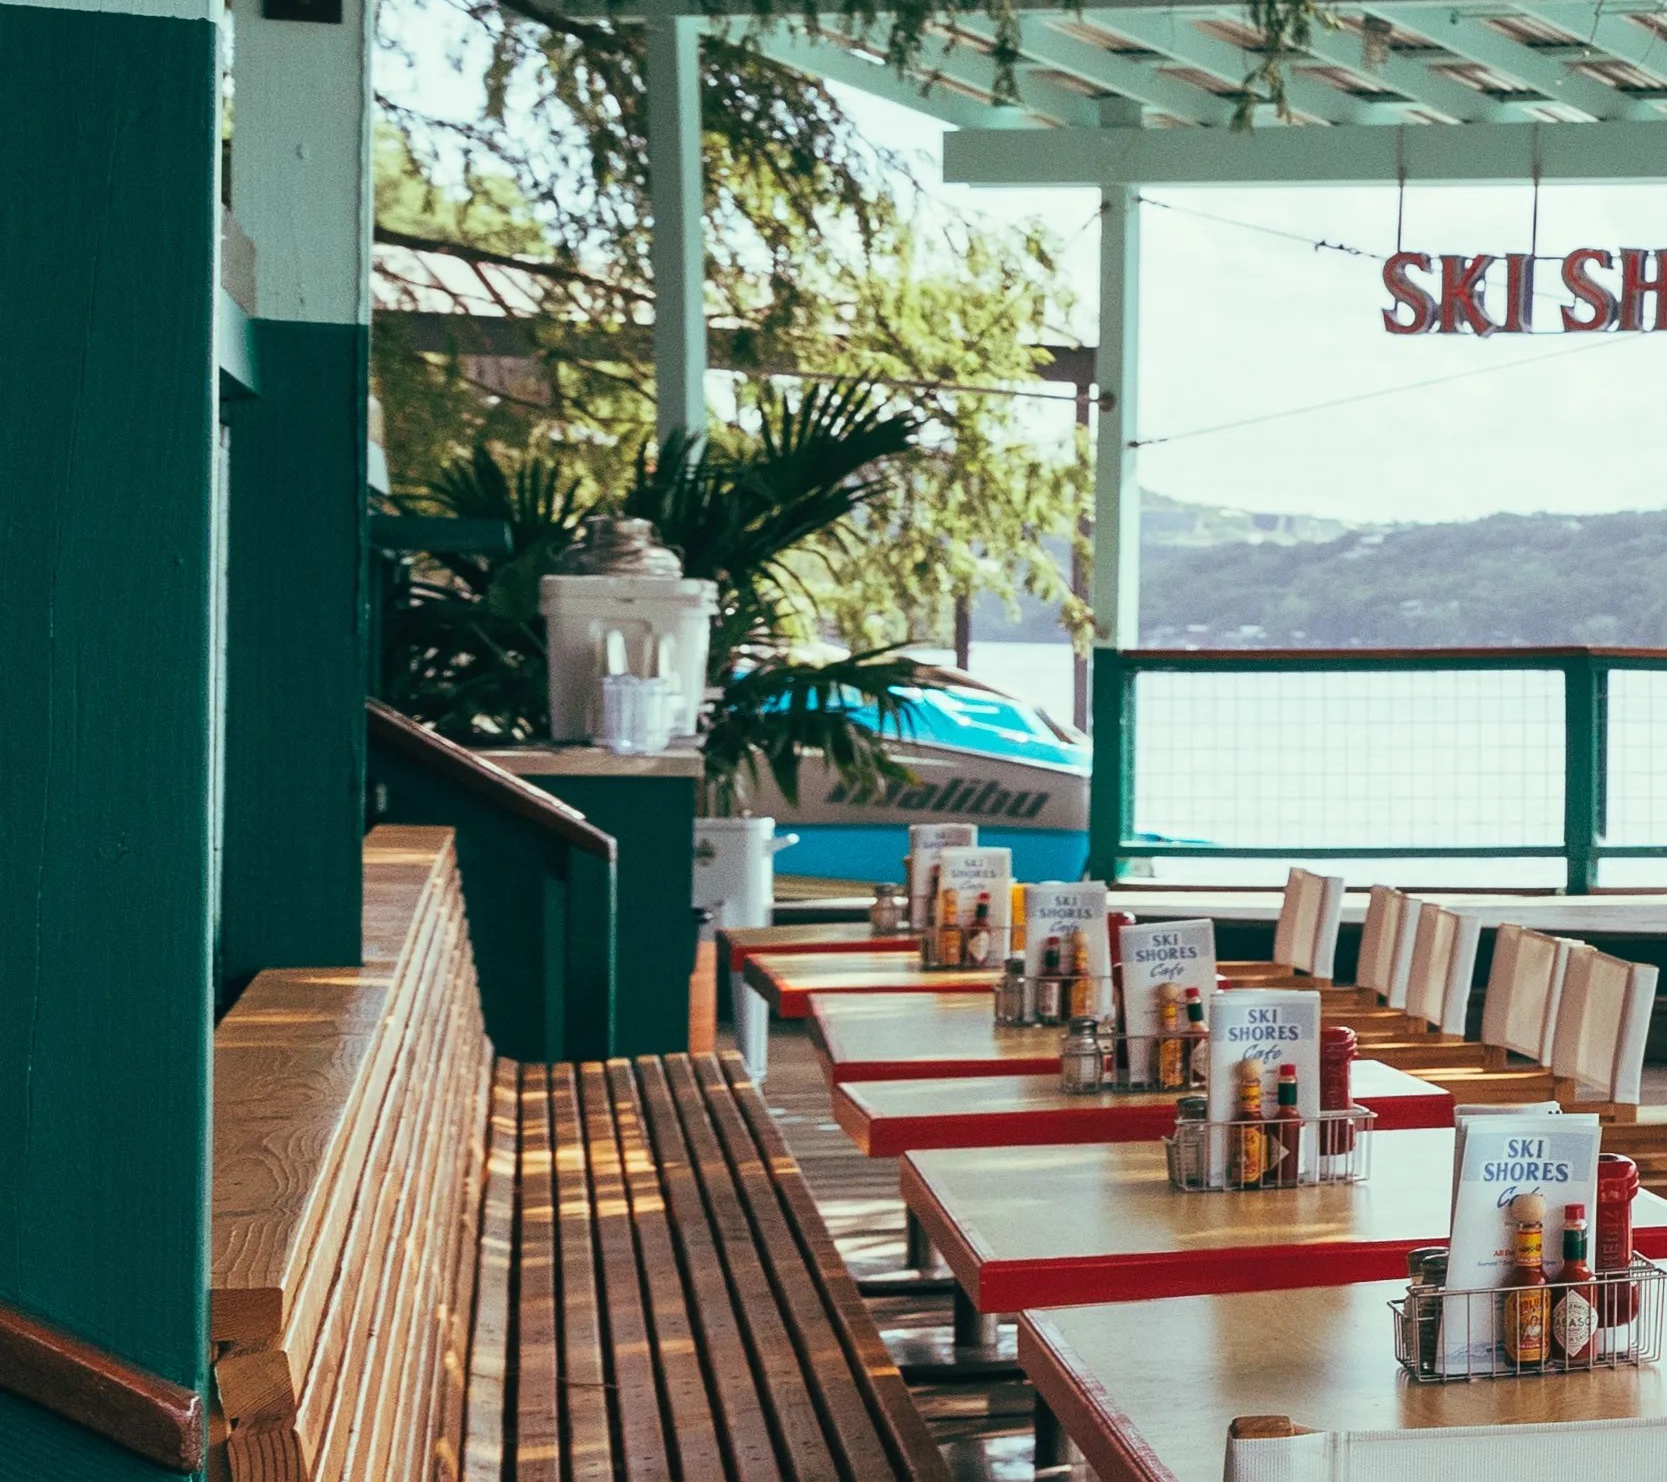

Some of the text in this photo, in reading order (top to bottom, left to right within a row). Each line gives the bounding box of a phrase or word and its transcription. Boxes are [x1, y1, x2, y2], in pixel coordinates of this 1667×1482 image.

[1381, 251, 1535, 337] SKI
[1055, 895, 1077, 906] SKI
[1152, 934, 1178, 947] SKI
[1135, 946, 1197, 962] SHORES
[1248, 1009, 1277, 1024] SKI
[1228, 1025, 1299, 1041] SHORES
[1508, 1139, 1544, 1159] SKI
[1483, 1162, 1569, 1182] SHORES
